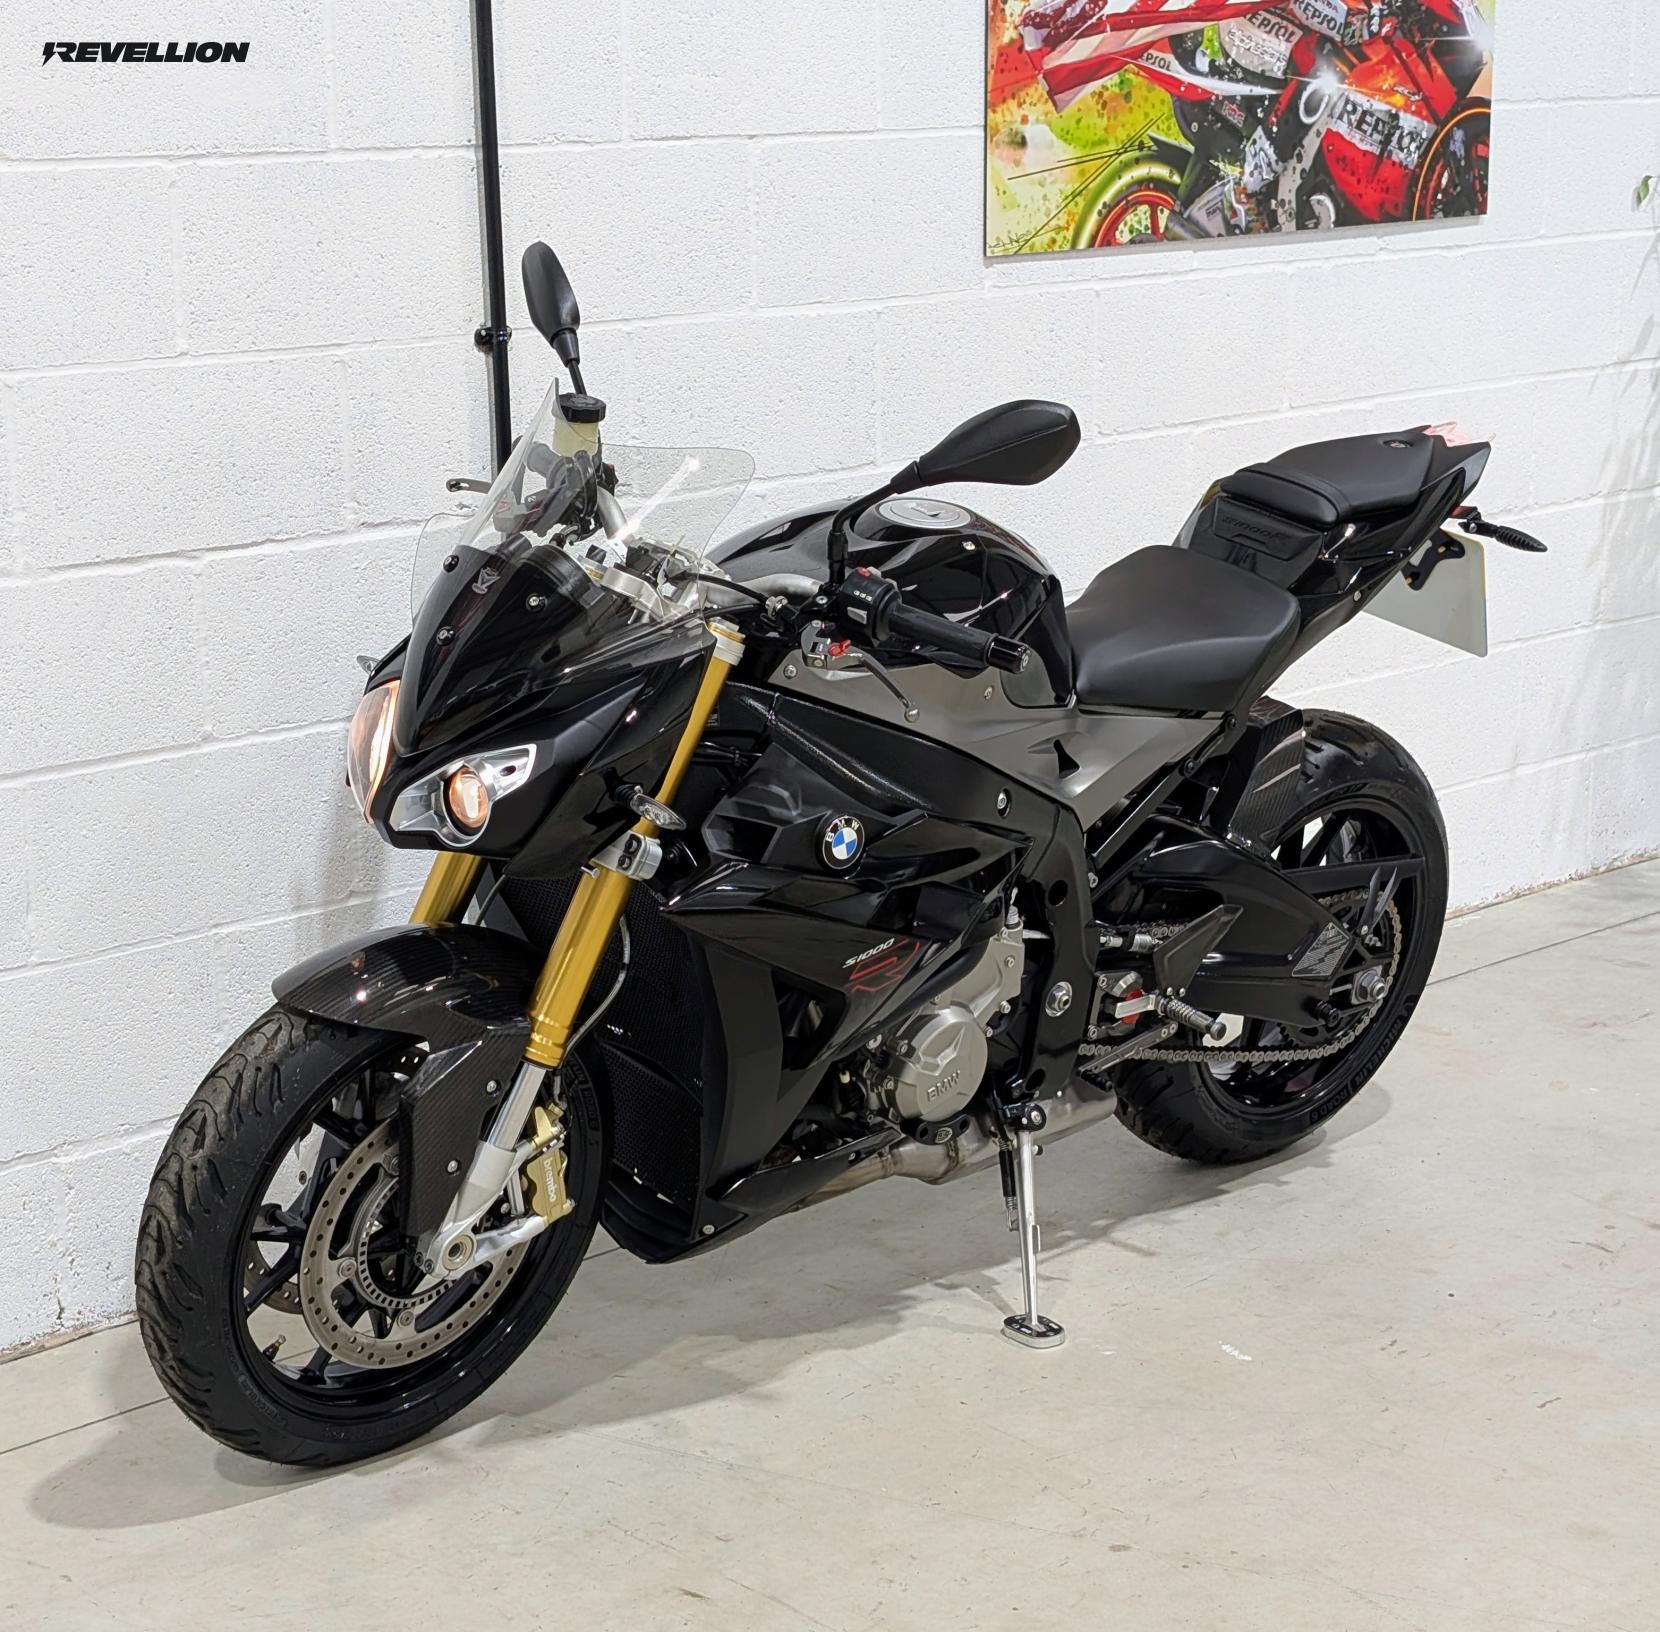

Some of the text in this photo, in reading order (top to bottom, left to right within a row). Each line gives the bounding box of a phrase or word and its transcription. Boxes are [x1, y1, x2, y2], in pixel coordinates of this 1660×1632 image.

[1244, 11, 1296, 43] EPSOL
[1141, 54, 1173, 72] EPSOL
[842, 937, 895, 969] S1000
[1353, 1018, 1403, 1082] MICHELIN
[926, 1070, 961, 1101] BMW
[543, 1157, 557, 1203] brembo
